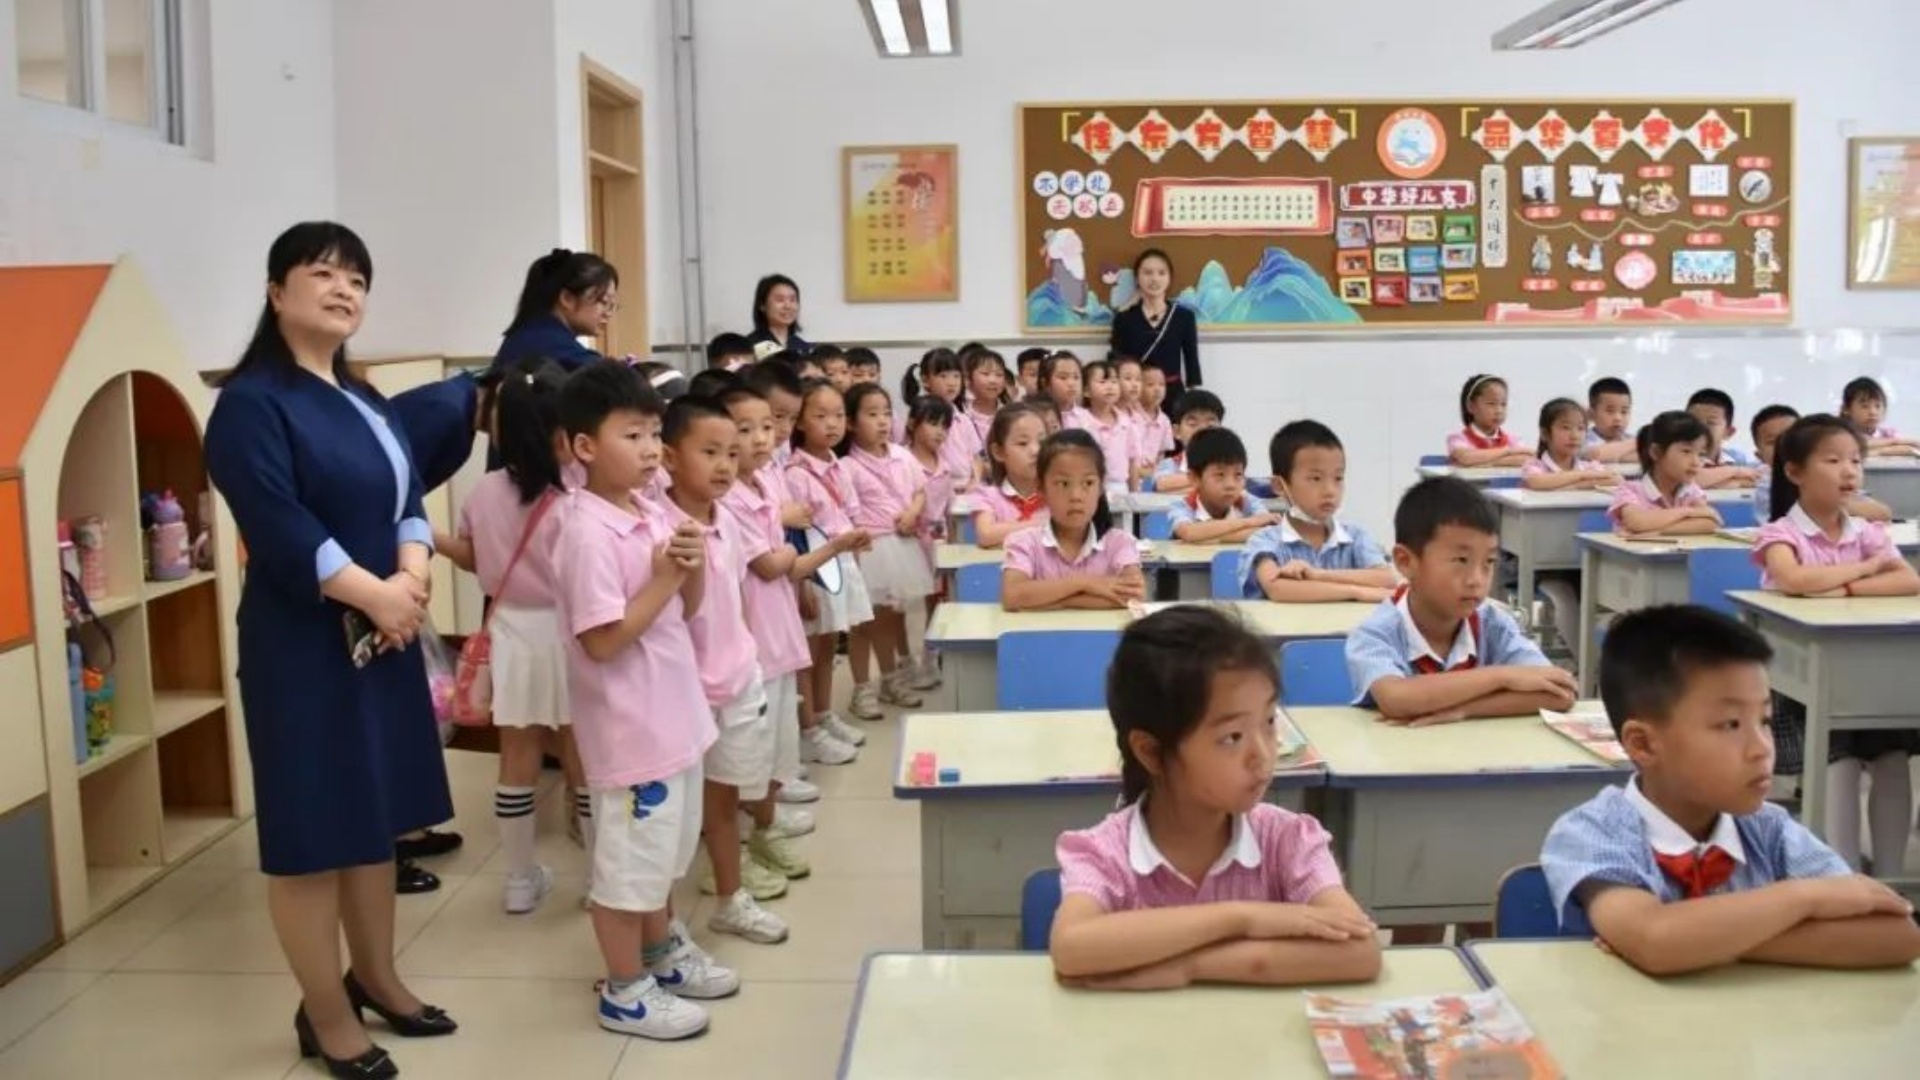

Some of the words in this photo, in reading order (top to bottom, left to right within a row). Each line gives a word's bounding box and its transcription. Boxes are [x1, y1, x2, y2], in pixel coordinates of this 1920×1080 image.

[1482, 117, 1728, 152] 品华夏文化
[1361, 186, 1458, 209] 中华好儿女
